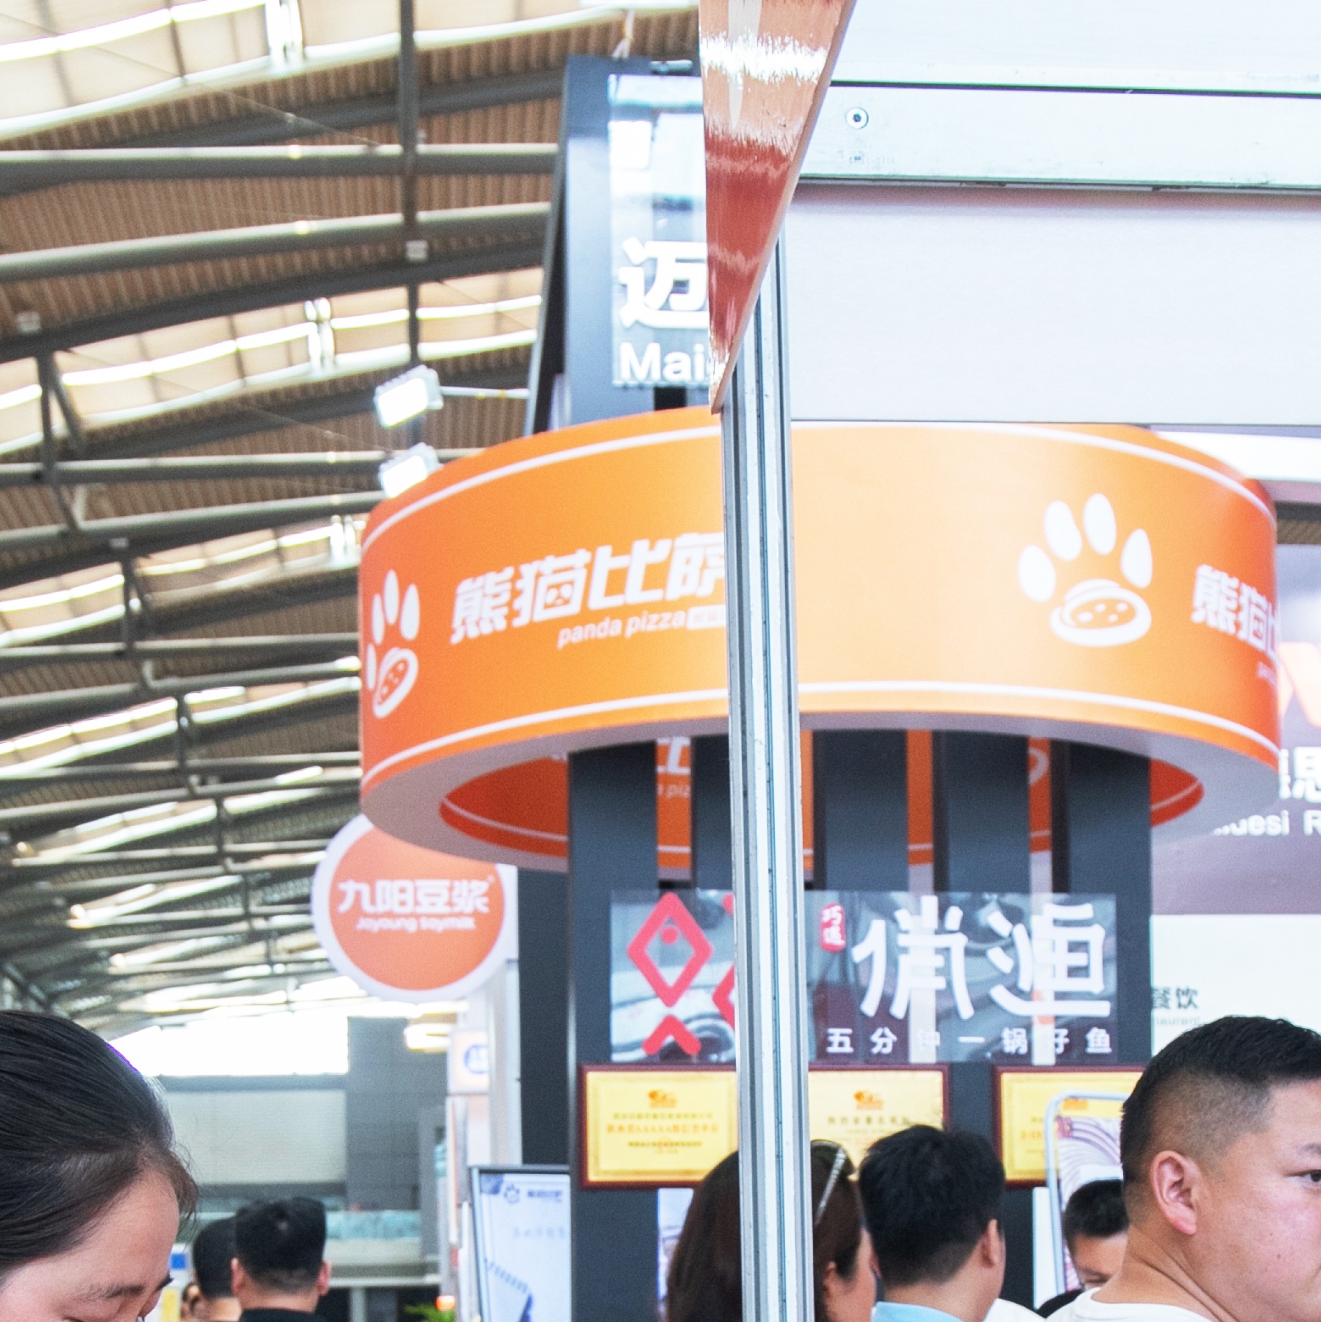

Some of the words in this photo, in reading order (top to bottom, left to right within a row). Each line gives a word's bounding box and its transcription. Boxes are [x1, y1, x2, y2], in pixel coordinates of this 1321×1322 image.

[556, 616, 622, 649] panda
[624, 609, 686, 638] pizza
[337, 878, 491, 915] 九阳豆浆
